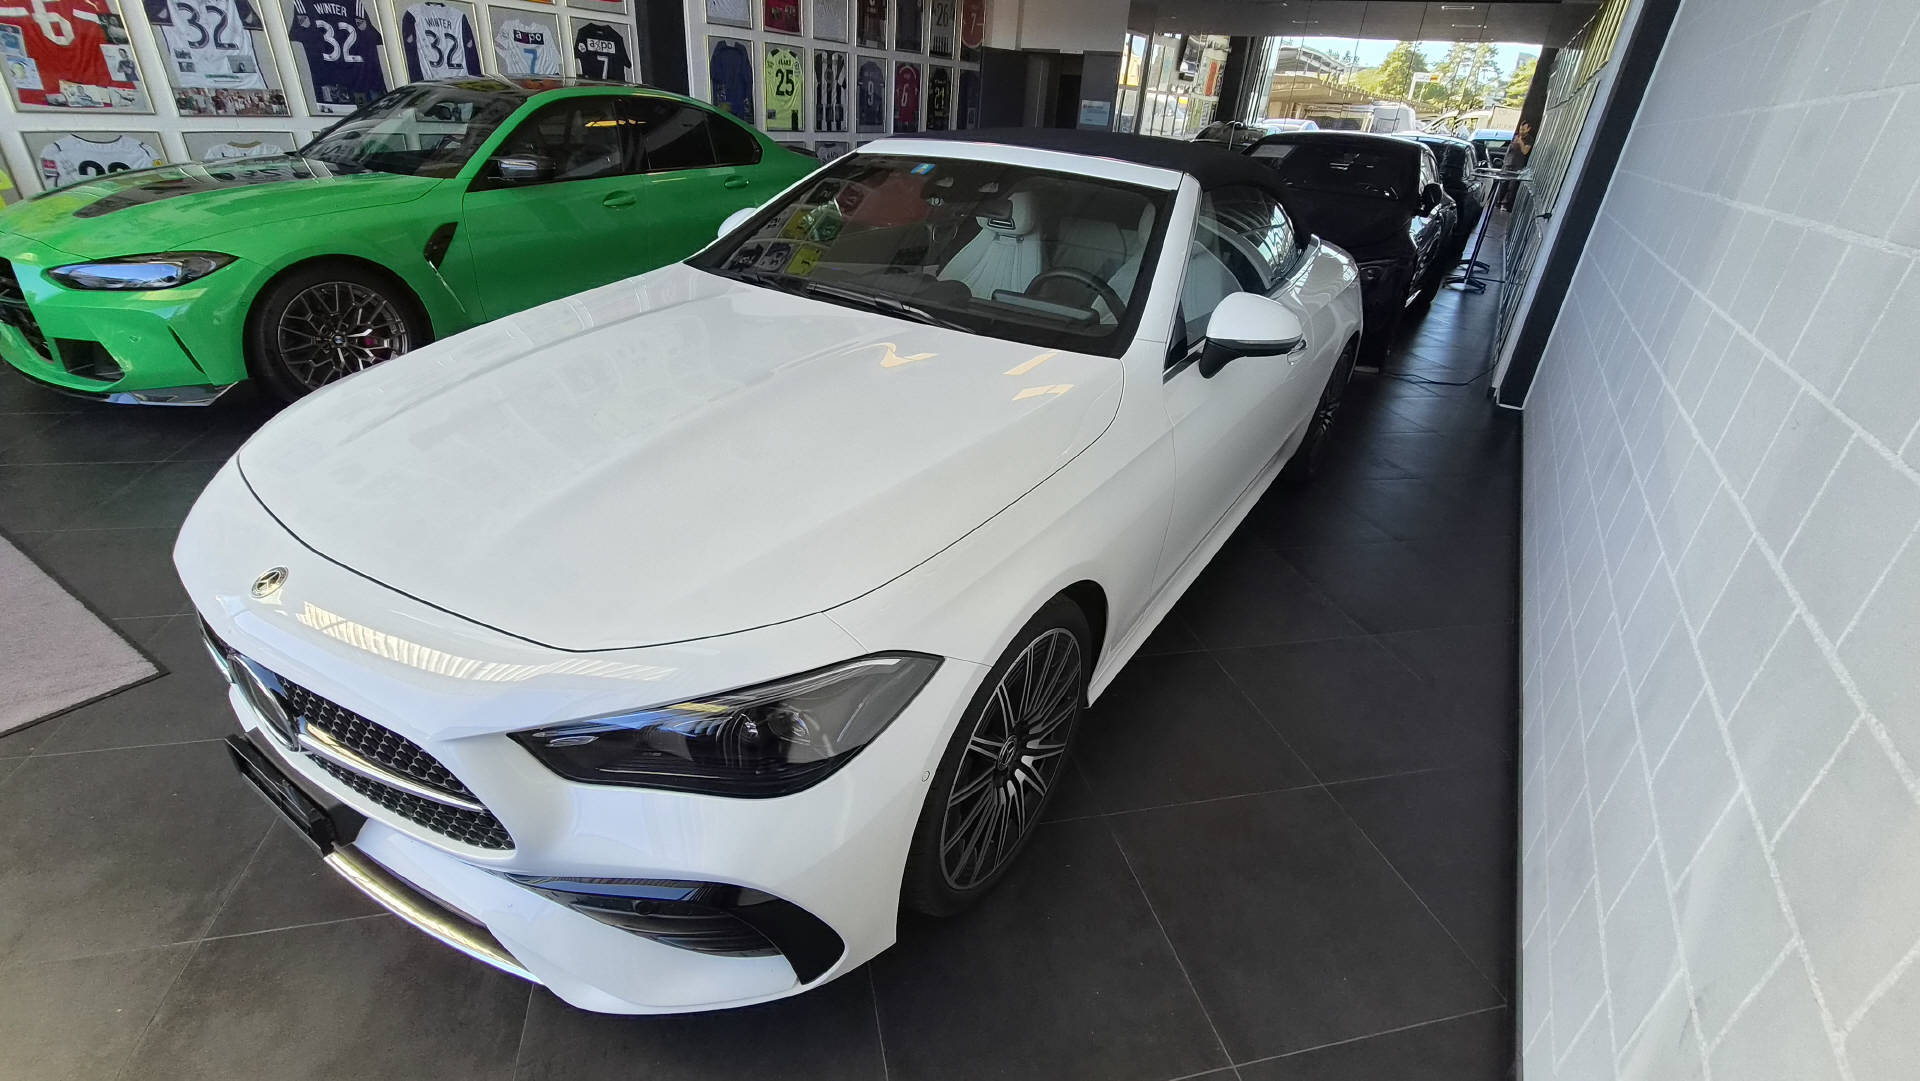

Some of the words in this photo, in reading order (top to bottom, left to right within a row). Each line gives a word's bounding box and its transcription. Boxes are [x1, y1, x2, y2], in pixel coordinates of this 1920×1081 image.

[313, 3, 348, 17] WINTER
[176, 2, 240, 50] 32
[424, 17, 452, 30] WINTER
[315, 19, 365, 63] 32
[424, 29, 464, 69] 32
[515, 30, 542, 43] apo
[523, 48, 538, 74] 7
[597, 56, 608, 80] 7
[775, 68, 795, 96] 25
[867, 81, 874, 106] 9
